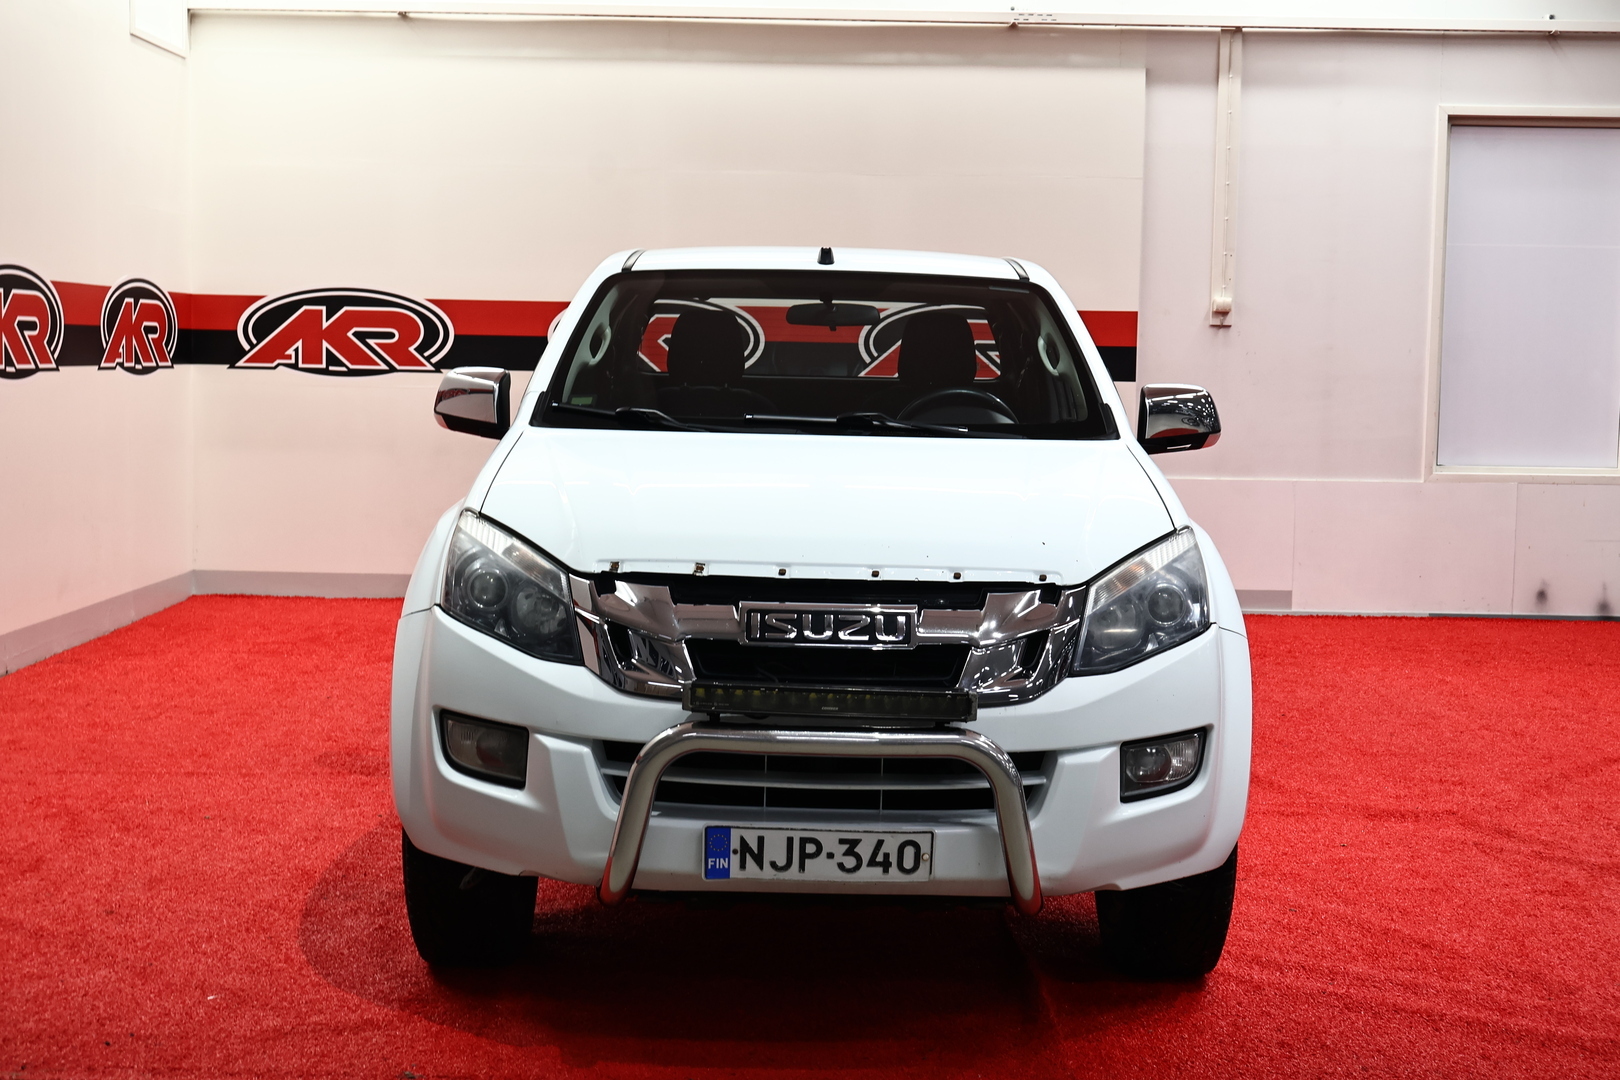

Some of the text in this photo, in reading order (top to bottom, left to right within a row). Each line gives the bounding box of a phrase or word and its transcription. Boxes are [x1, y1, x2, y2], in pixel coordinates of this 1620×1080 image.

[0, 287, 57, 370] KR
[100, 298, 173, 369] AKR
[230, 305, 436, 370] AKR
[751, 612, 906, 641] ISUZU
[708, 857, 729, 870] FIN
[739, 834, 922, 876] NJP-340
